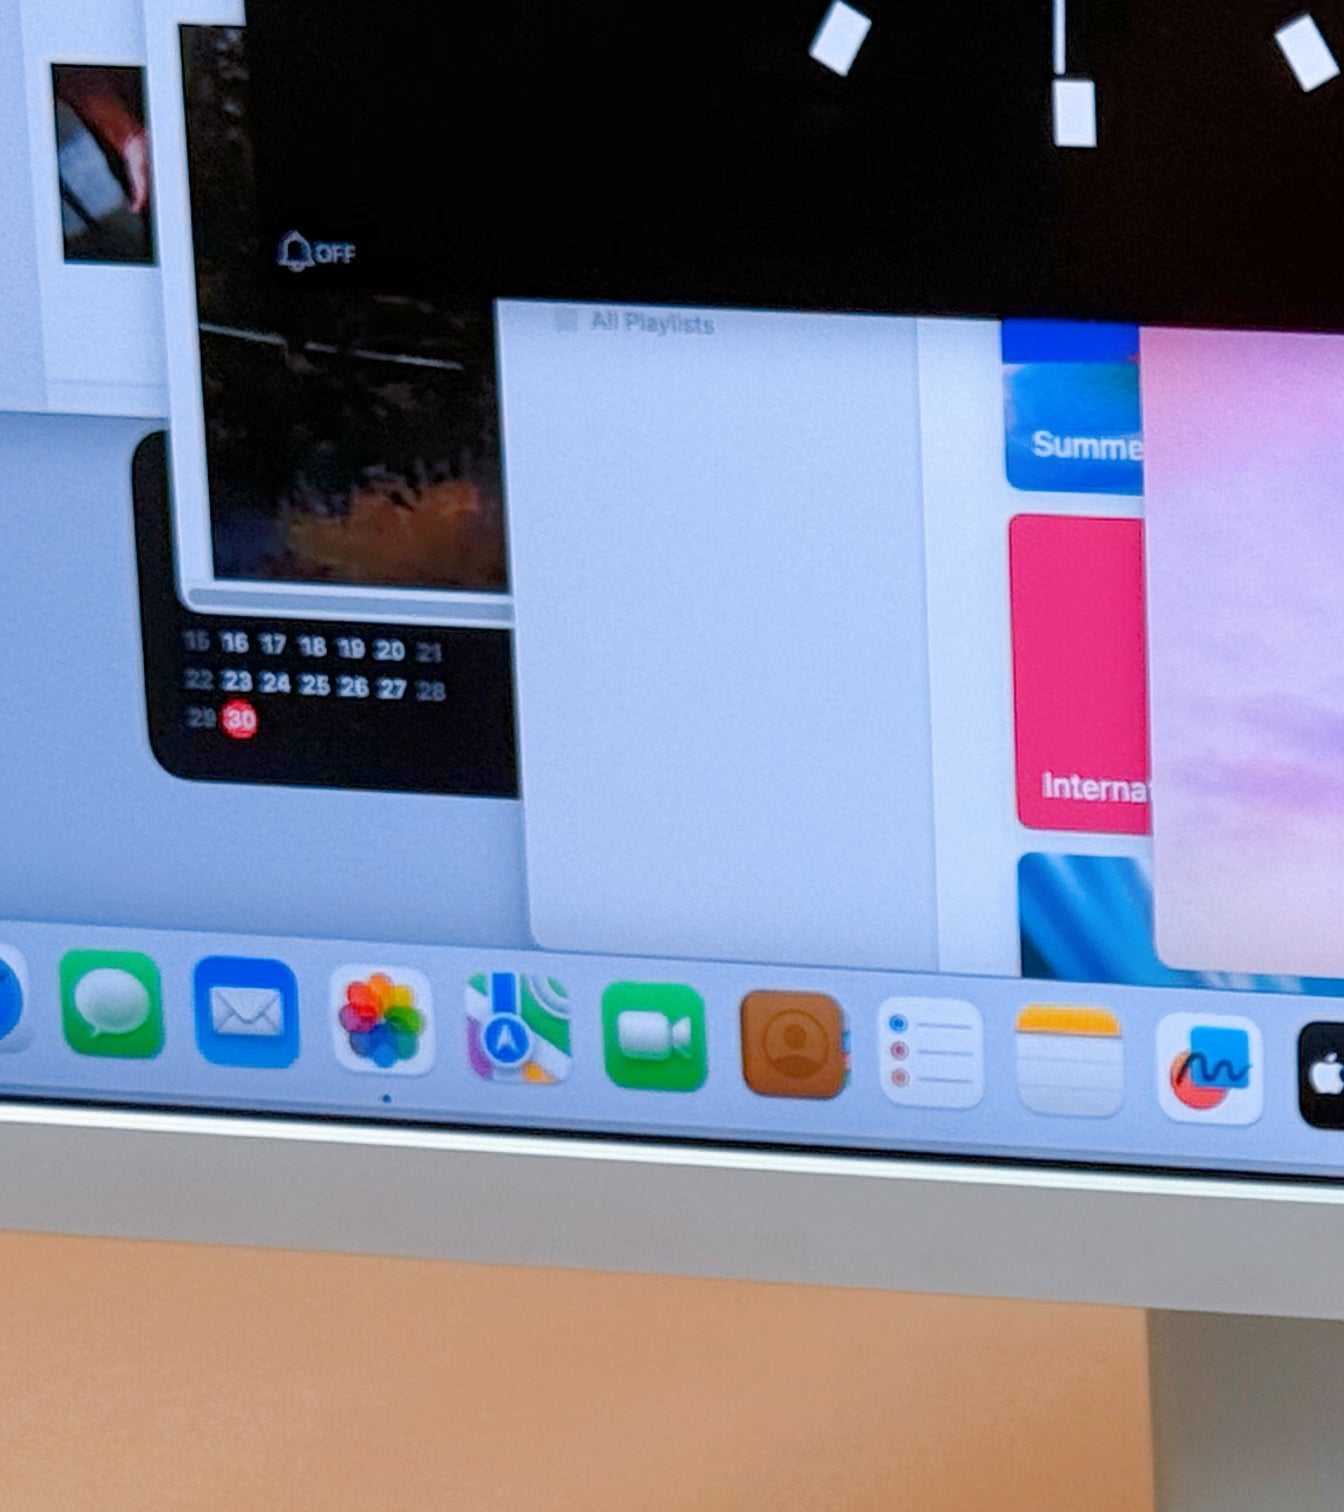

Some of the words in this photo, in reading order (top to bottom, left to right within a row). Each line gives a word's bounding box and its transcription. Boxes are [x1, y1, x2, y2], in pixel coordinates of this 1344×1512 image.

[314, 242, 356, 265] OFF
[222, 632, 249, 653] 16
[263, 633, 288, 655] 17
[303, 635, 328, 657] 18
[375, 638, 406, 661] 20
[222, 669, 252, 692] 23
[261, 671, 292, 694] 24
[303, 674, 331, 696] 25
[340, 675, 371, 698] 26
[378, 678, 407, 700] 27
[228, 709, 257, 730] 30
